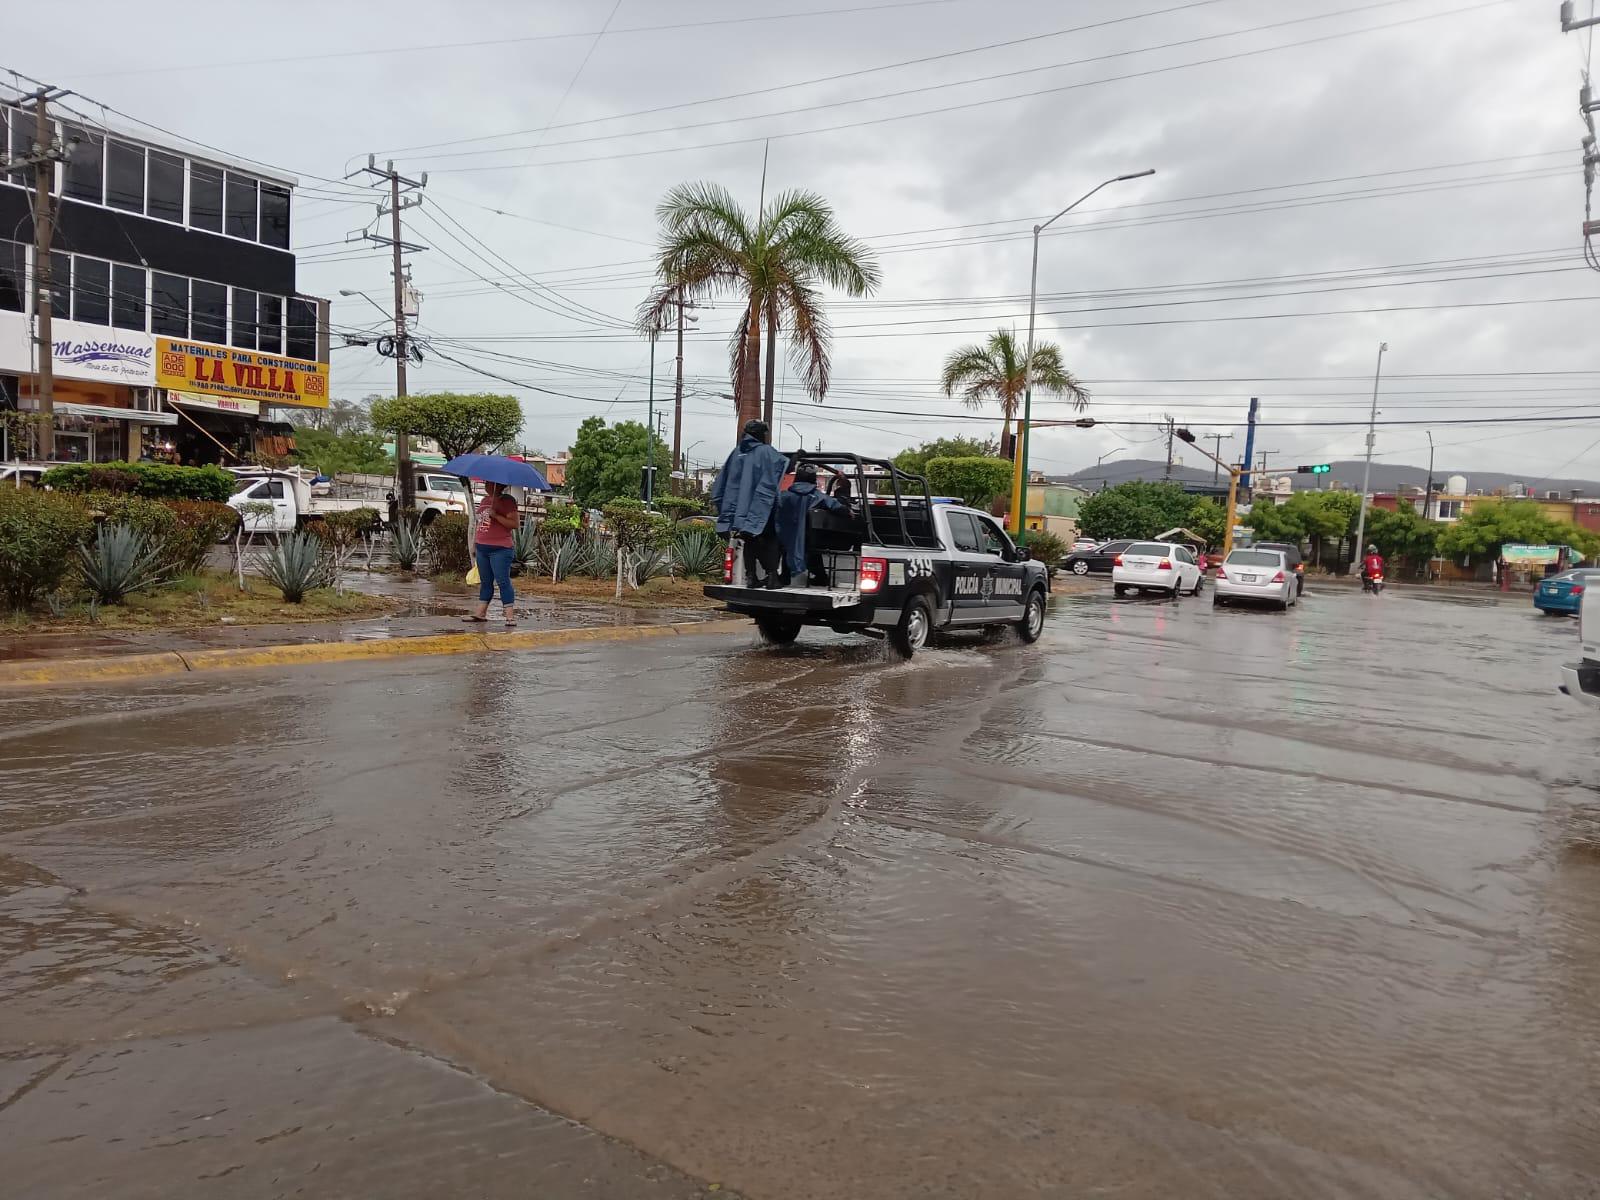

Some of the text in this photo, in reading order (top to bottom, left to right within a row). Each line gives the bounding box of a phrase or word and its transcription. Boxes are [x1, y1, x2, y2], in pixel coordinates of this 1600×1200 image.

[52, 341, 153, 358] Massensual
[170, 343, 317, 373] MATERIALES PARA CONSTRUCCION
[195, 357, 224, 383] LA
[233, 363, 296, 393] VILLA
[907, 555, 933, 577] 319
[954, 573, 1022, 595] POLICÍA MUNICIPAL
